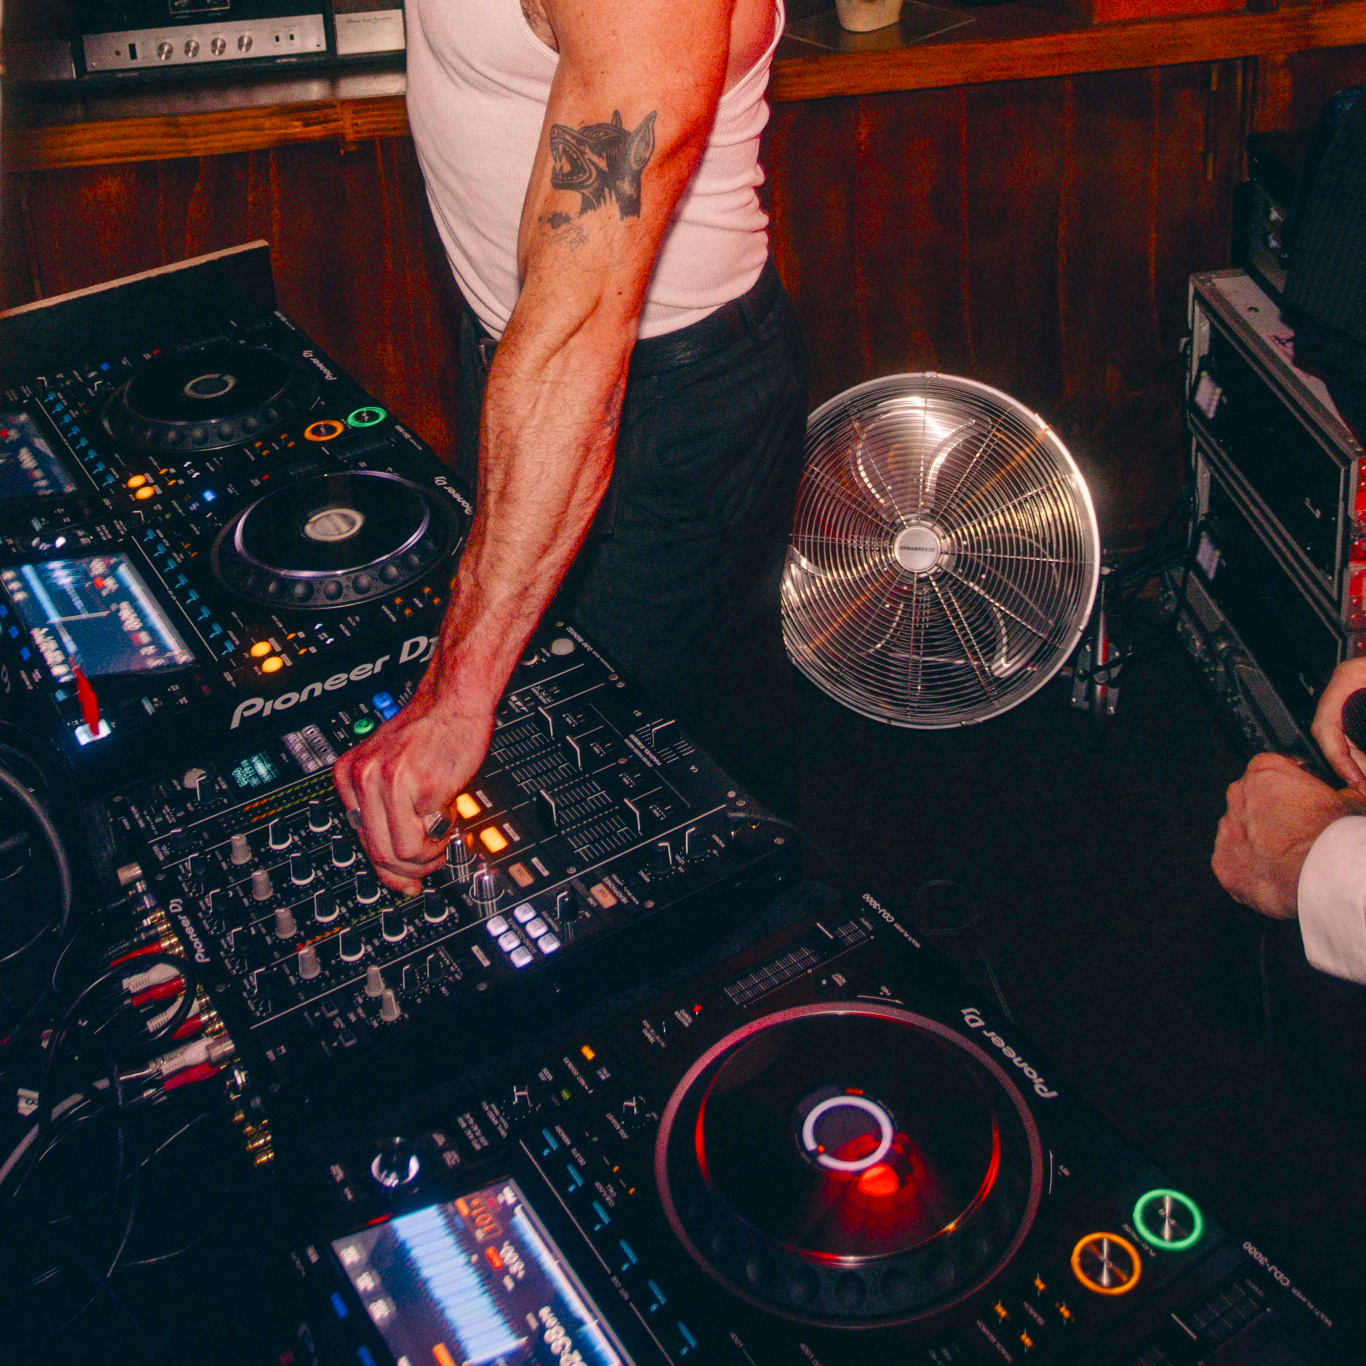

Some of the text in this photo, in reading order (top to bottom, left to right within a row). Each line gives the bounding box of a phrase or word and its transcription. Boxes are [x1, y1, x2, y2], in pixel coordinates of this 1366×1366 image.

[308, 355, 337, 384] Pioneer
[441, 482, 476, 517] Pioneer
[229, 634, 441, 730] Pioneer DJ
[861, 891, 895, 923] CDJ-3000
[170, 911, 213, 966] Pioneer
[960, 1007, 1058, 1100] Pioneer DJ
[1241, 1239, 1292, 1287] CDJ-3000
